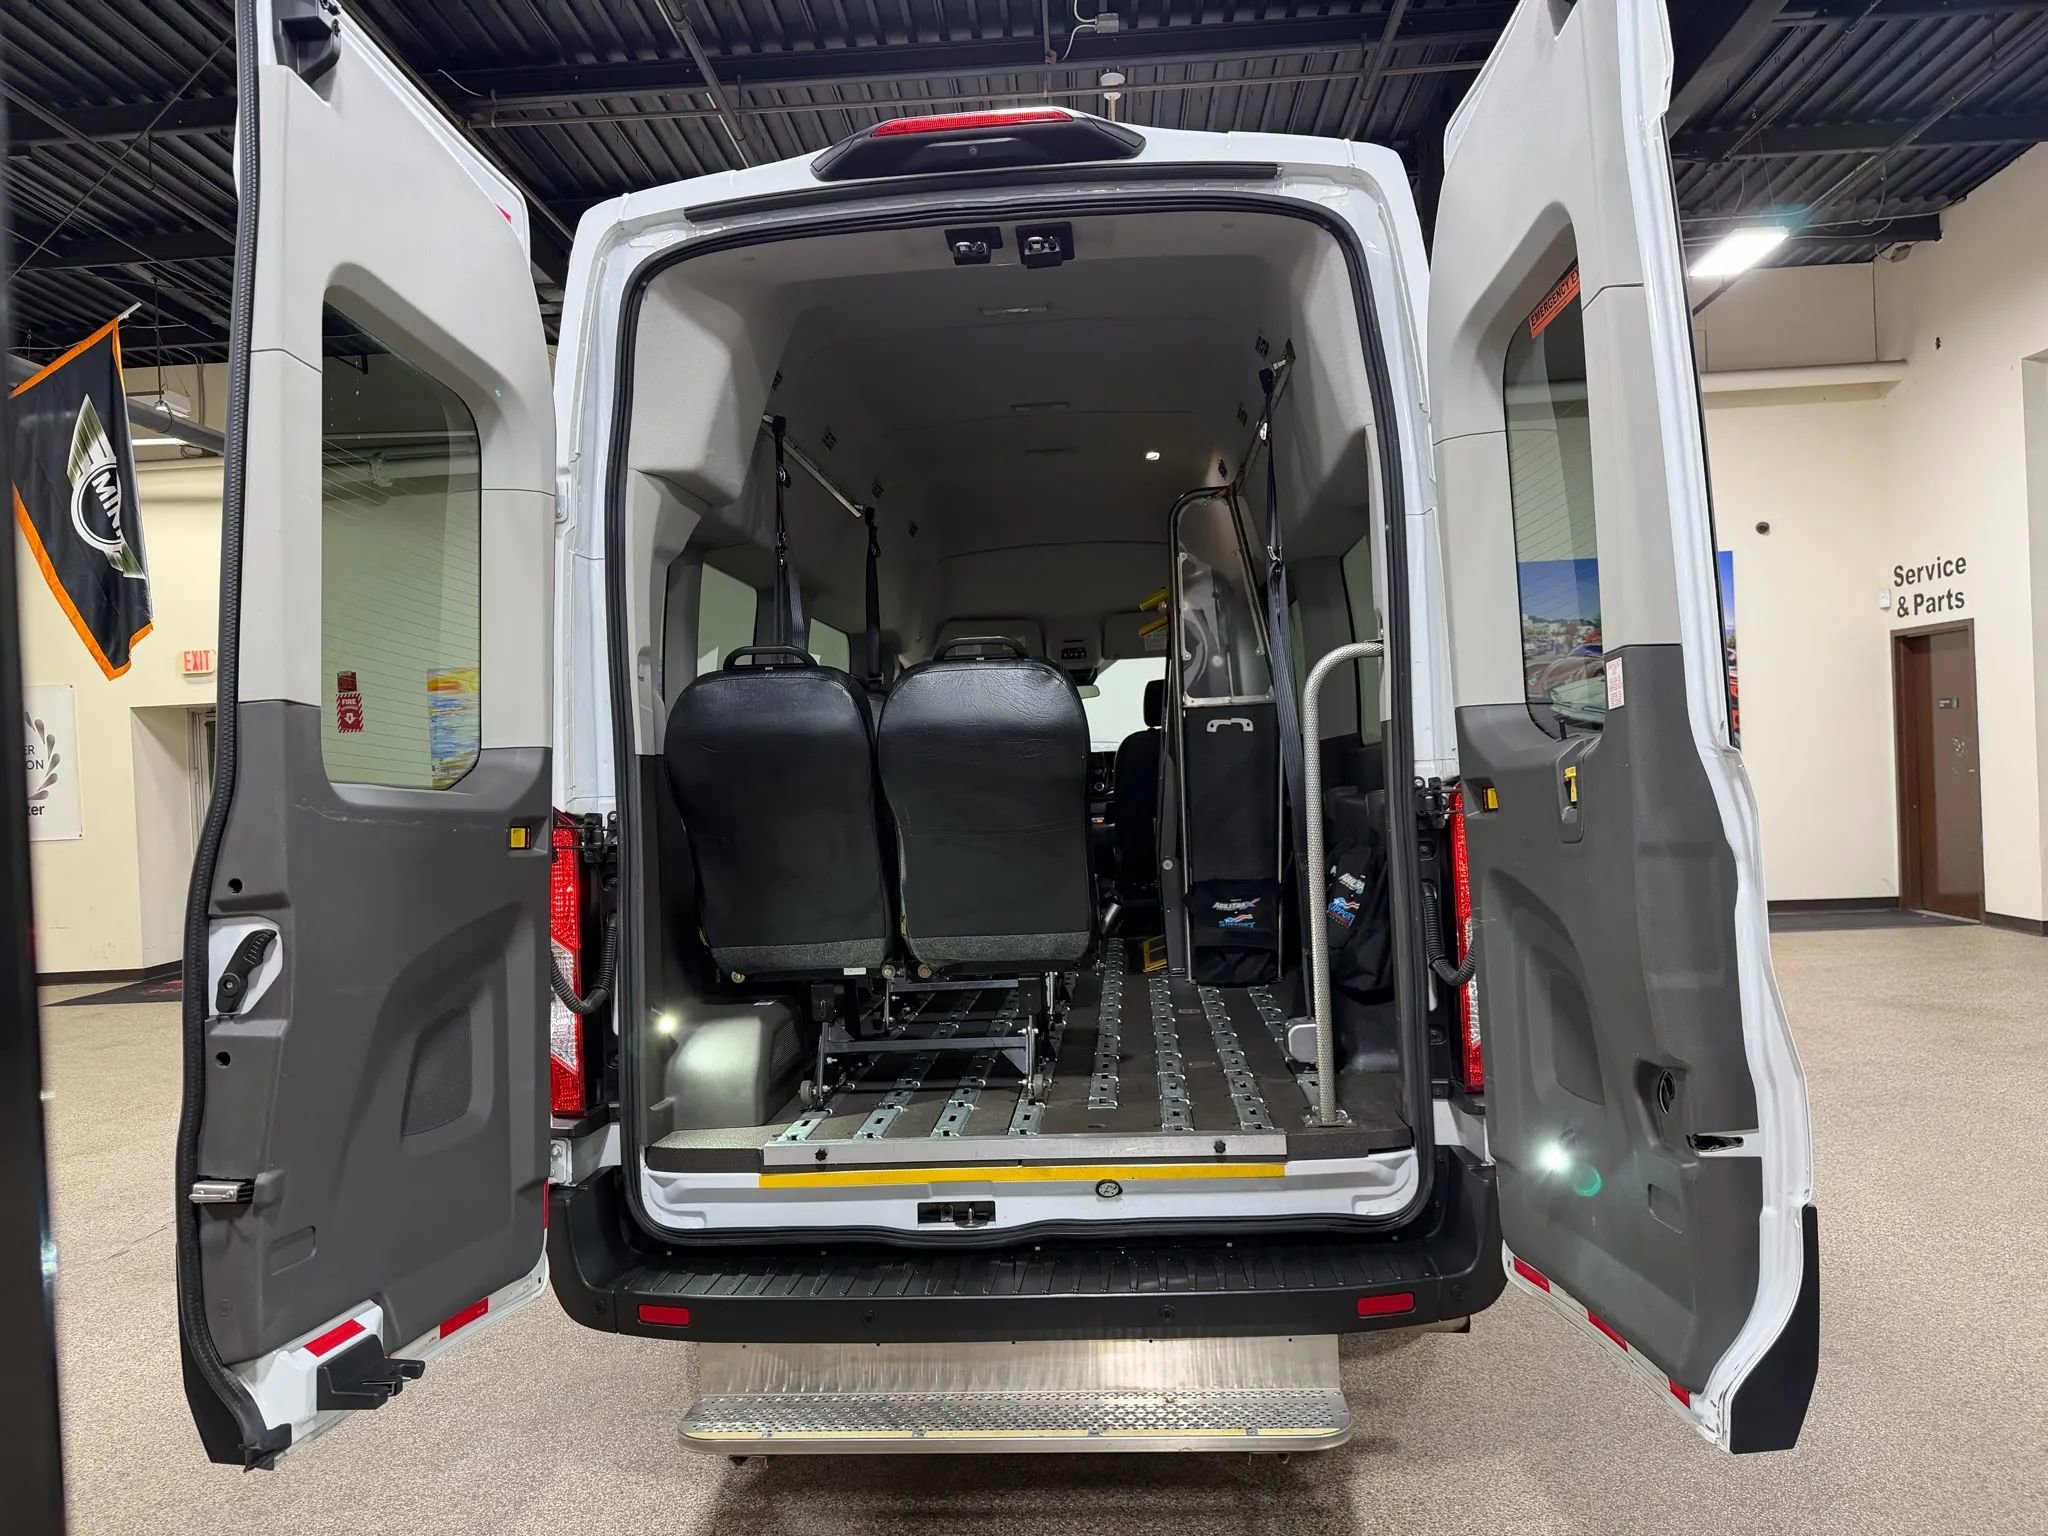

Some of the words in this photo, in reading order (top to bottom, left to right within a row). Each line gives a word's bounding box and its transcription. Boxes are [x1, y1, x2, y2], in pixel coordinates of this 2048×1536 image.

[1530, 280, 1571, 327] EMERGENCY
[1893, 556, 1967, 587] Service
[1897, 596, 1910, 618] &
[1913, 588, 1965, 615] Parts
[183, 650, 210, 671] EXIT
